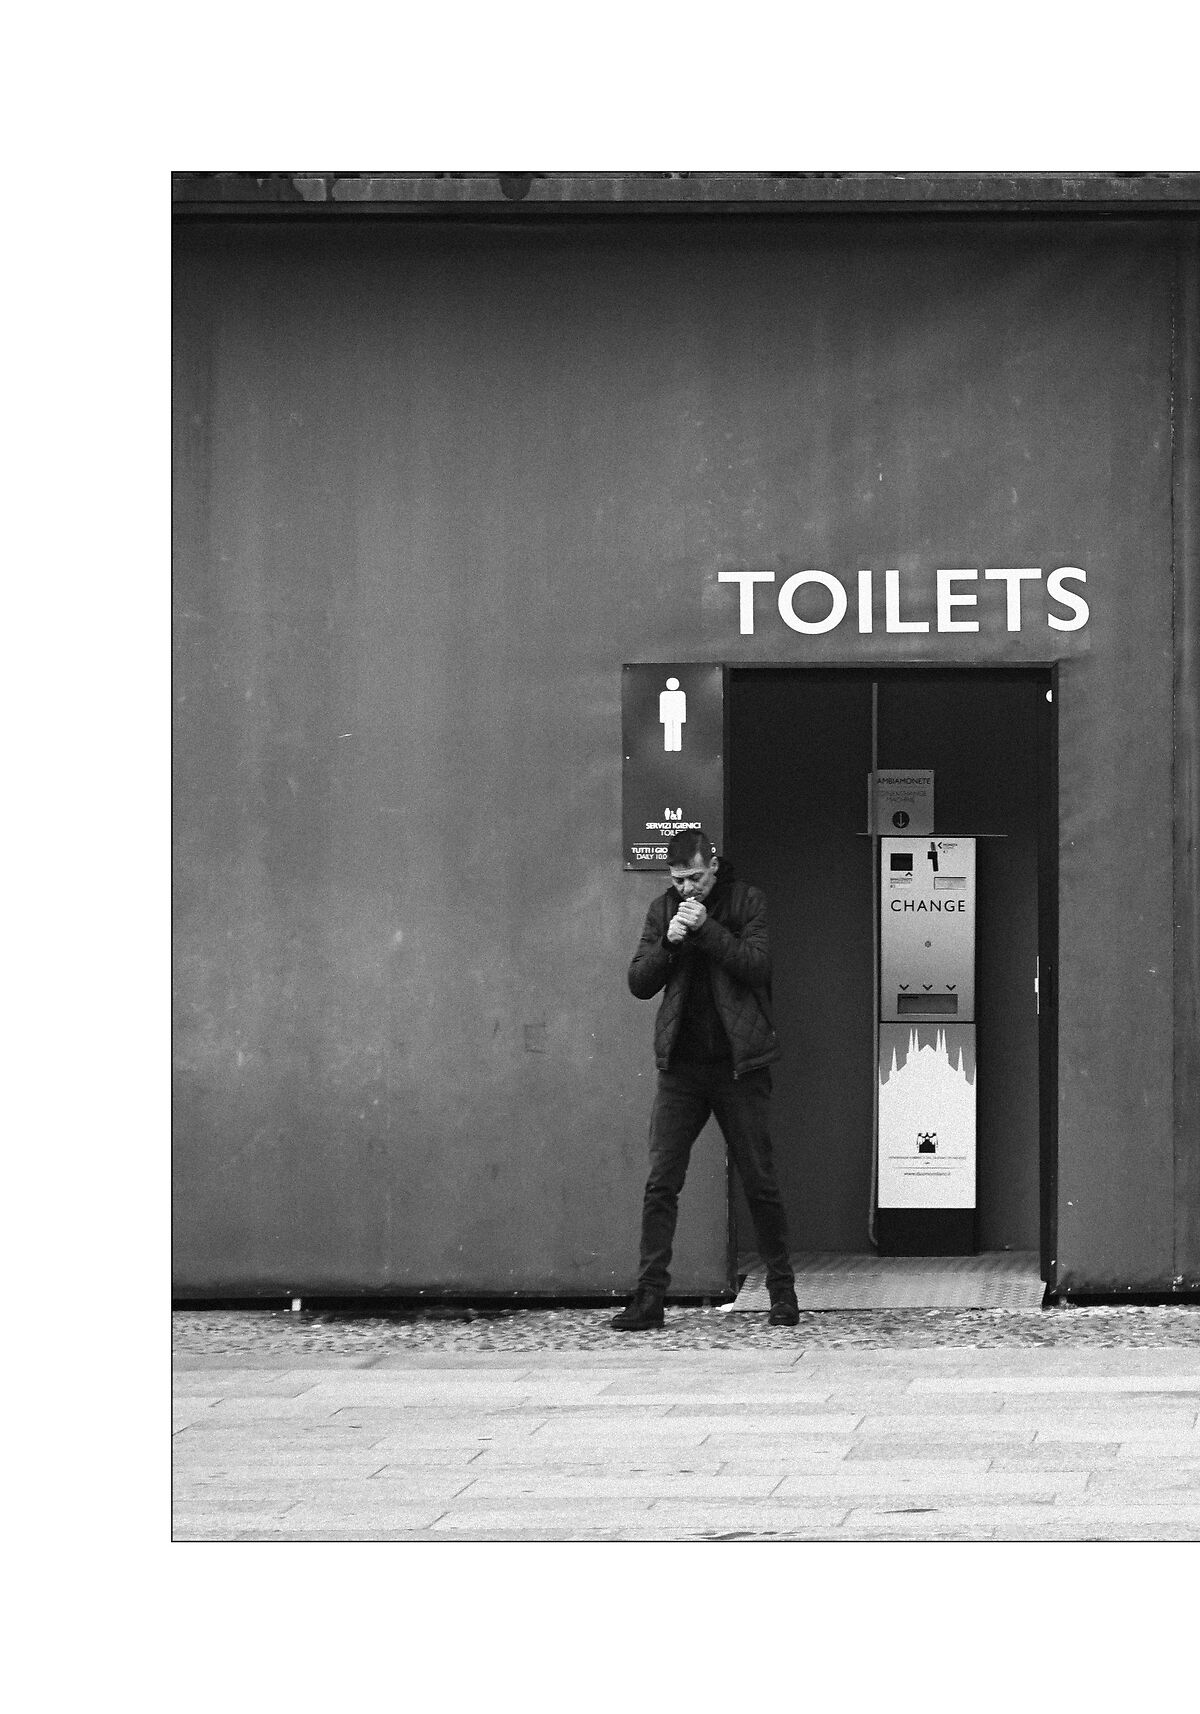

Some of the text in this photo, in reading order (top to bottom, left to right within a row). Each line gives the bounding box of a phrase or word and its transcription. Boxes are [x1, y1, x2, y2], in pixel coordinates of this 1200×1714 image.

[718, 567, 1090, 635] TOILETS
[645, 822, 702, 830] SERVIZI IGIENICI
[890, 899, 966, 912] CHANGE
